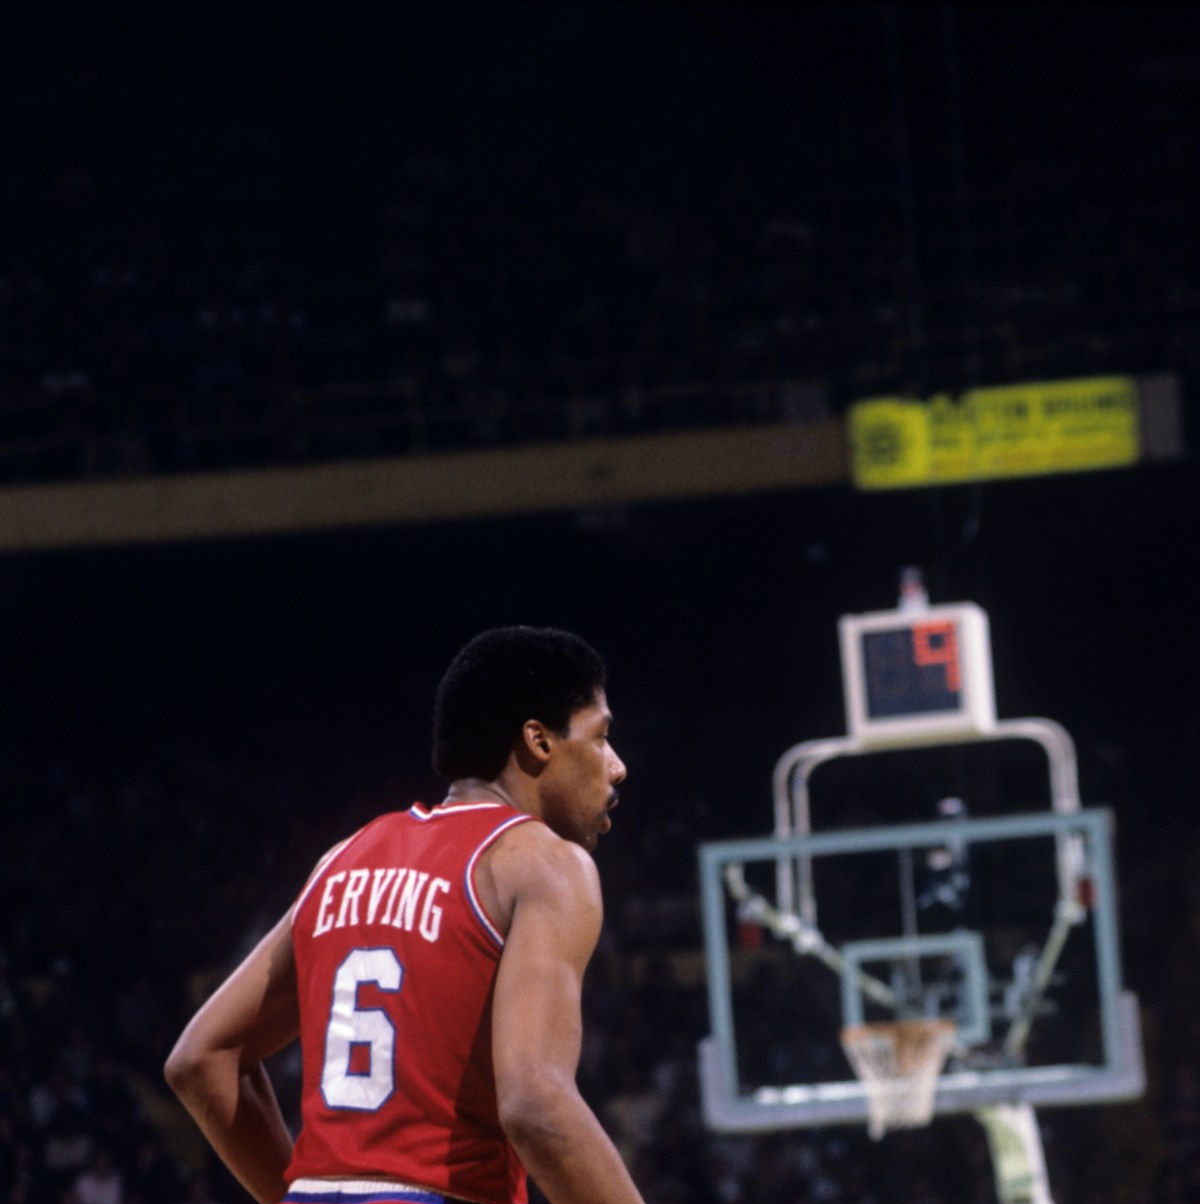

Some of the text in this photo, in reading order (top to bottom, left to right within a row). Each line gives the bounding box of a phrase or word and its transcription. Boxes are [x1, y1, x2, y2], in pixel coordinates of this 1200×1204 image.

[912, 619, 961, 692] 9
[312, 867, 450, 943] ERVING
[319, 946, 405, 1111] 6
